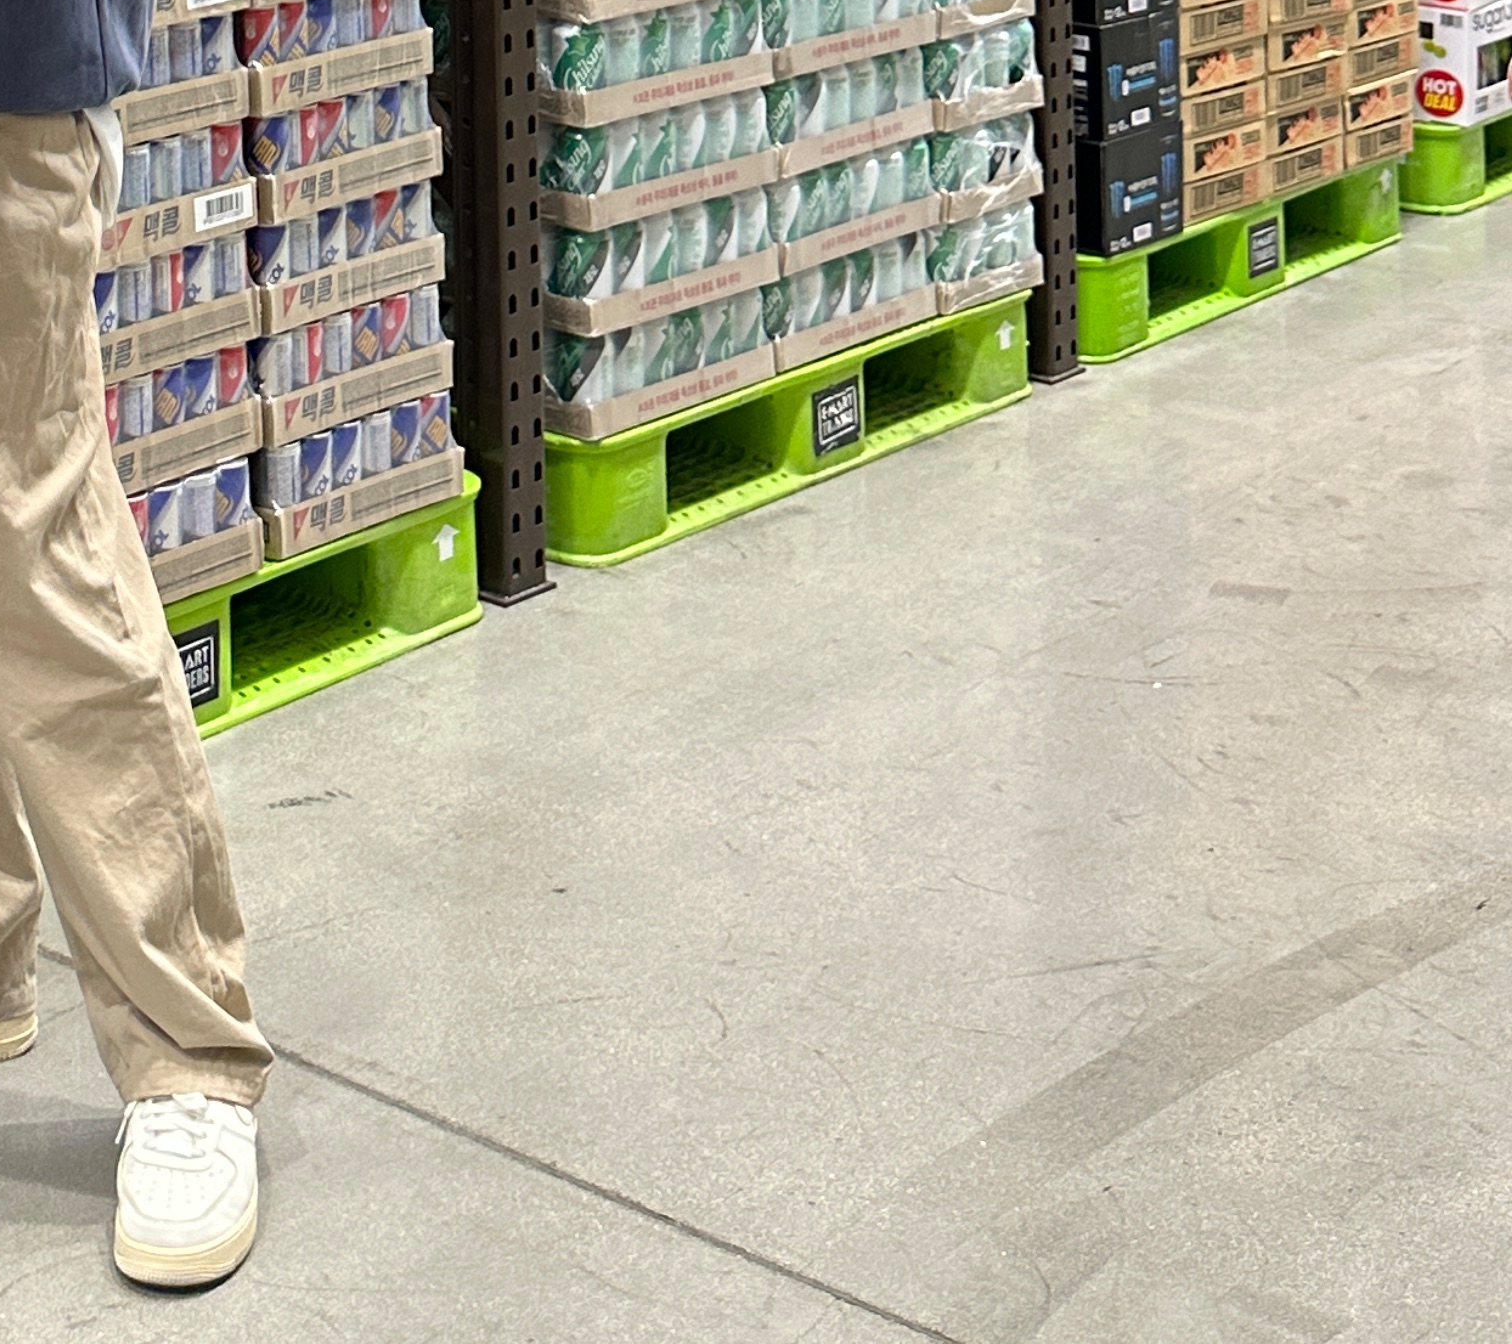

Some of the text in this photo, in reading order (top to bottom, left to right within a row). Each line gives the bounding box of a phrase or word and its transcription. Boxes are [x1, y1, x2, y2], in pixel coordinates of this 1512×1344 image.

[289, 64, 324, 98] 맥콜
[1422, 77, 1457, 94] HOT
[1423, 92, 1456, 112] DEAL
[300, 168, 335, 204] 맥콜
[143, 205, 180, 241] 맥콜
[299, 273, 335, 310] 맥콜
[301, 385, 337, 422] 맥콜
[309, 493, 346, 531] 맥콜
[184, 642, 210, 671] ART
